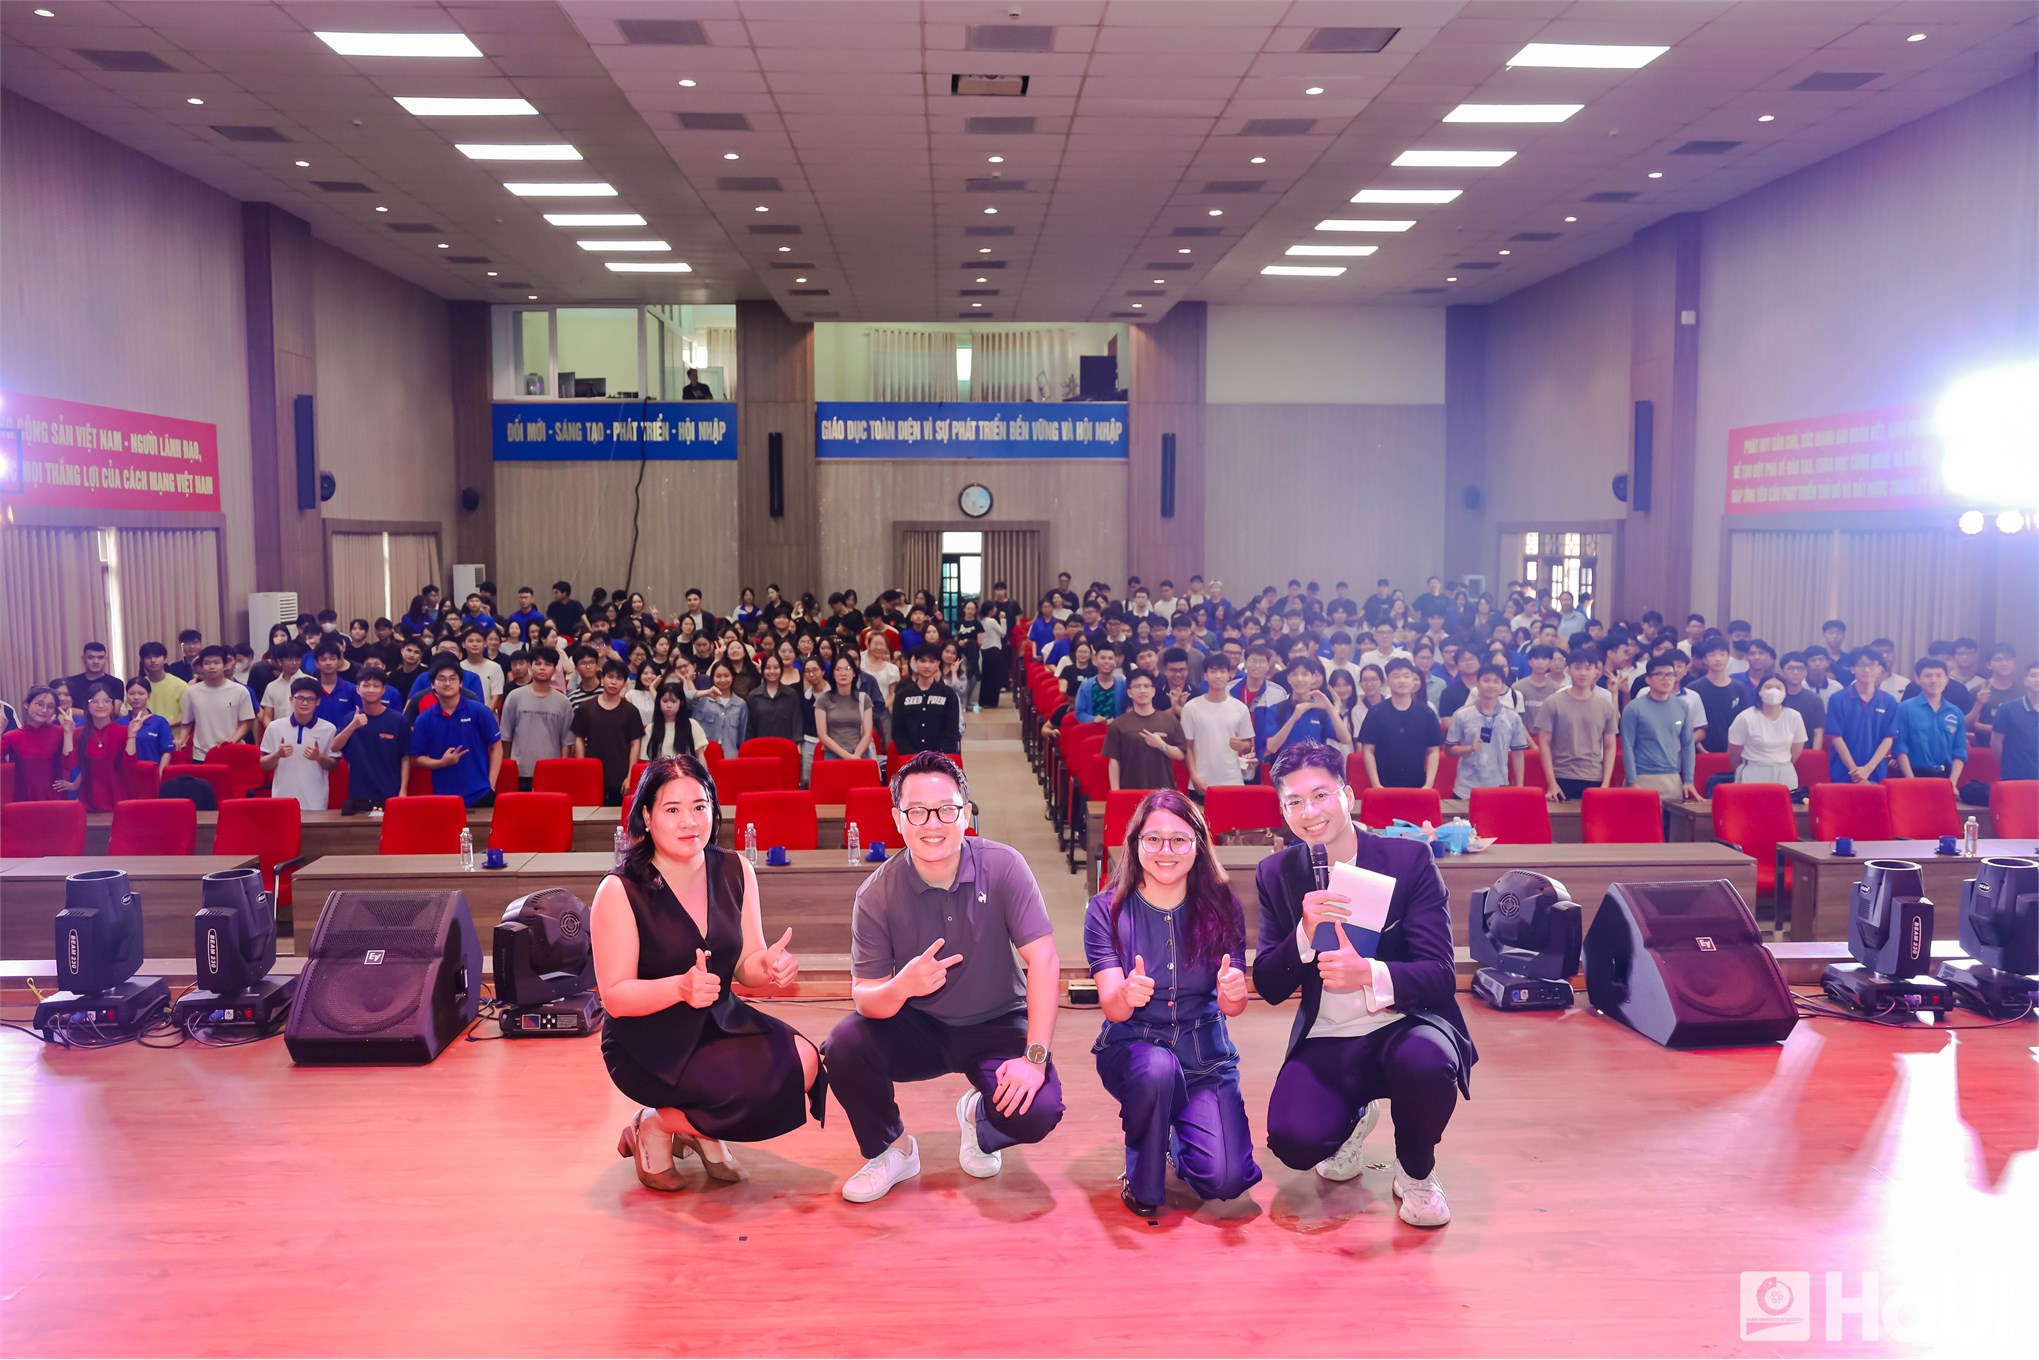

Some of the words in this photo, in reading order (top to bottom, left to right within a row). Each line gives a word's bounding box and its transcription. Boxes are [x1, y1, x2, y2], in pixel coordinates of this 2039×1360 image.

[51, 414, 74, 447] SẢN
[75, 423, 97, 453] VIỆT
[100, 428, 122, 452] NAM
[130, 430, 158, 456] NGƯỜI
[159, 434, 182, 458] LÃNH
[507, 413, 524, 442] ĐỔI
[527, 417, 546, 442] MỚI
[555, 418, 582, 442] SÁNG
[585, 421, 604, 444] TẠO
[613, 417, 638, 442] PHÁT
[640, 413, 669, 442] TRIỂN
[678, 417, 695, 445] HỘI
[698, 417, 726, 445] NHẬP
[821, 416, 845, 440] GIÁO
[846, 420, 867, 444] DỤC
[869, 417, 895, 440] TOÀN
[898, 417, 921, 444] DIỆN
[923, 416, 933, 440] VÌ
[935, 418, 950, 444] SỰ
[952, 417, 976, 440] PHÁT
[978, 413, 1007, 440] TRIỂN
[1032, 418, 1059, 441] VỮNG
[1061, 417, 1074, 441] VÀ
[1076, 417, 1092, 444] HỘI
[1095, 417, 1123, 445] NHẬP
[45, 456, 81, 486] THẮNG
[83, 465, 99, 493] LỢI
[101, 459, 122, 489] CỦA
[123, 465, 148, 490] CÁCH
[149, 471, 175, 496] MẠNG
[176, 470, 193, 497] VIỆT
[195, 475, 213, 494] NAM
